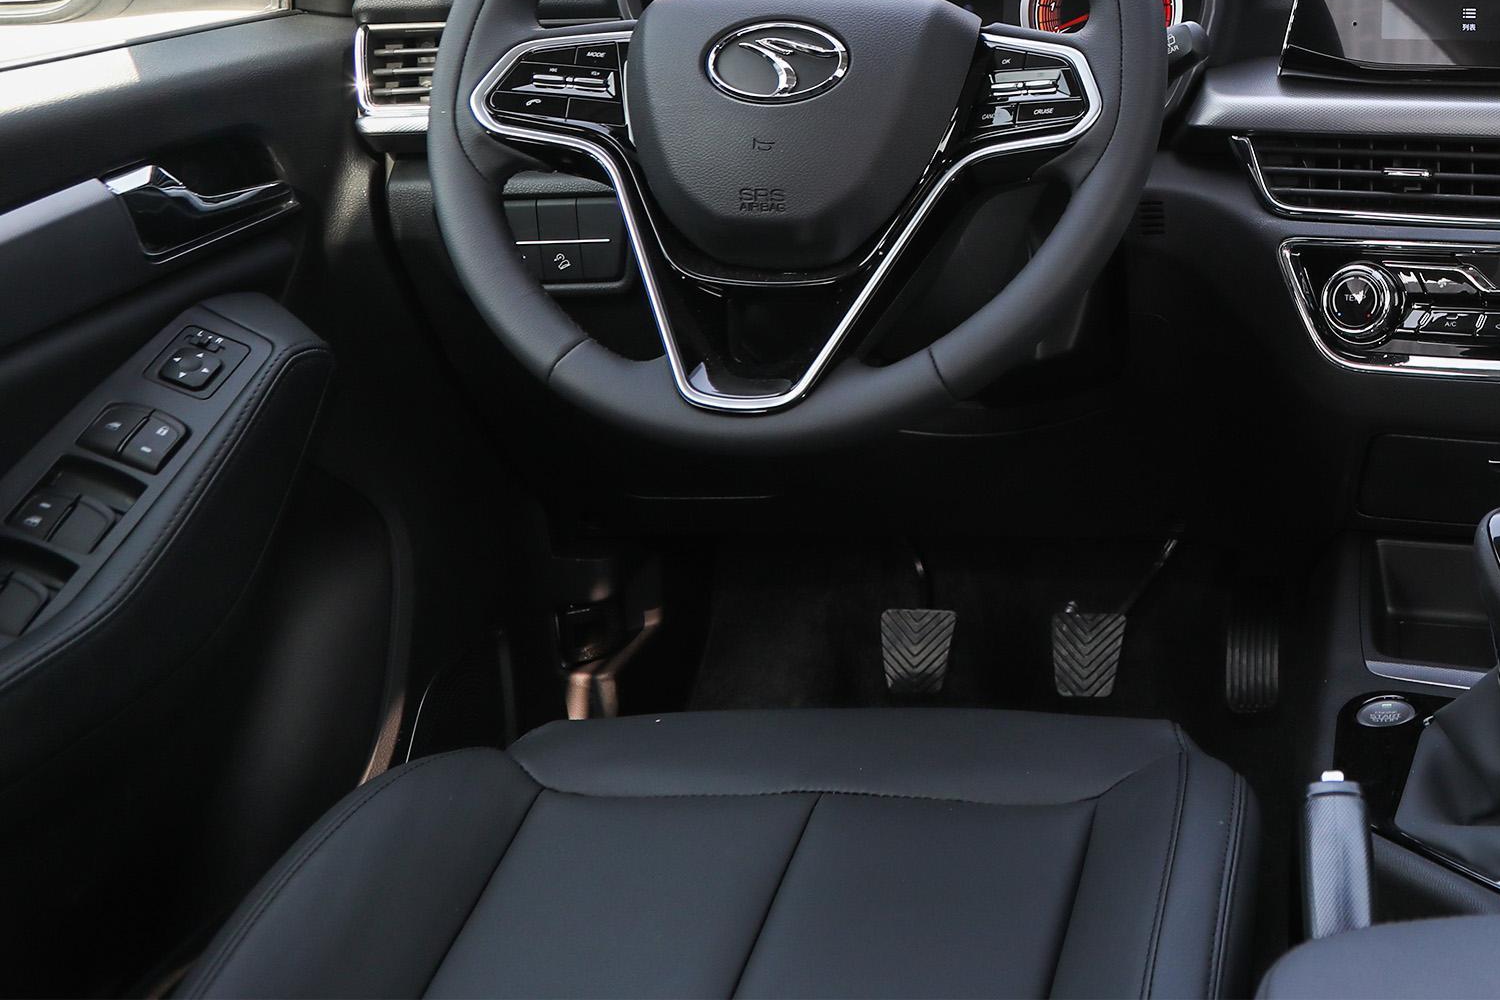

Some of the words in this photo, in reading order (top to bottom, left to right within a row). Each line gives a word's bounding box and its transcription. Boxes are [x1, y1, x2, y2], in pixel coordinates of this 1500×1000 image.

[1050, 1, 1056, 11] 1
[1462, 23, 1476, 31] 列表
[1167, 44, 1180, 55] EAR
[1033, 107, 1054, 115] CRUISE
[739, 188, 785, 202] SRS
[1344, 293, 1366, 301] TEP
